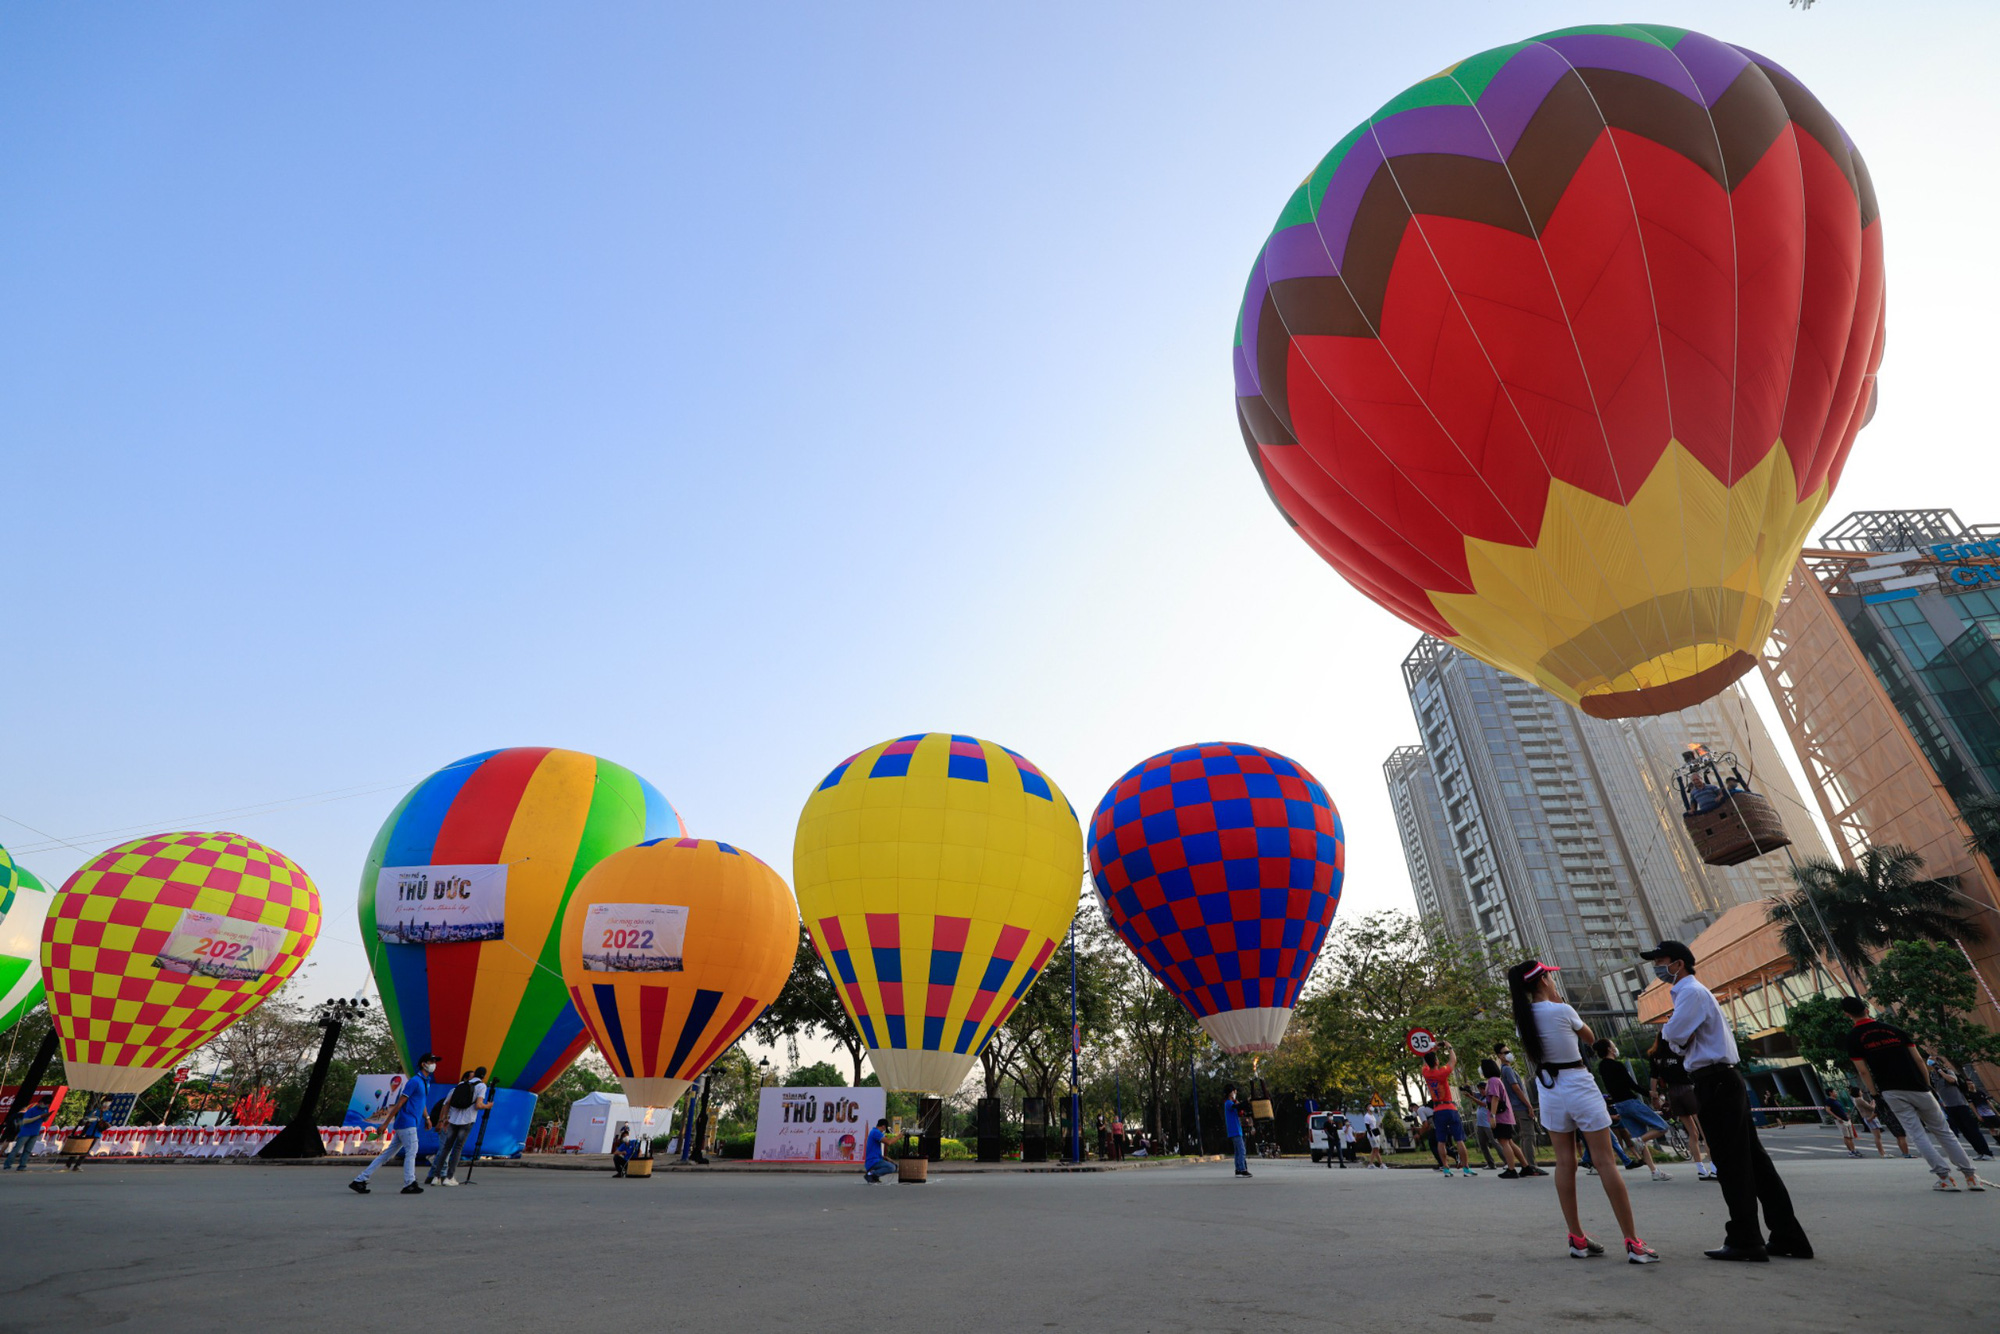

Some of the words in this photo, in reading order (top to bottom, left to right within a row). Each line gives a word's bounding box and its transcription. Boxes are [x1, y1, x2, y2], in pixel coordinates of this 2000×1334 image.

[1951, 565, 2000, 586] Cit
[398, 875, 428, 901] THỦ
[433, 875, 471, 900] ĐỨC
[193, 937, 254, 962] 2022
[602, 929, 654, 949] 2022
[782, 1096, 817, 1123] THỦ
[822, 1097, 859, 1123] ĐỨC
